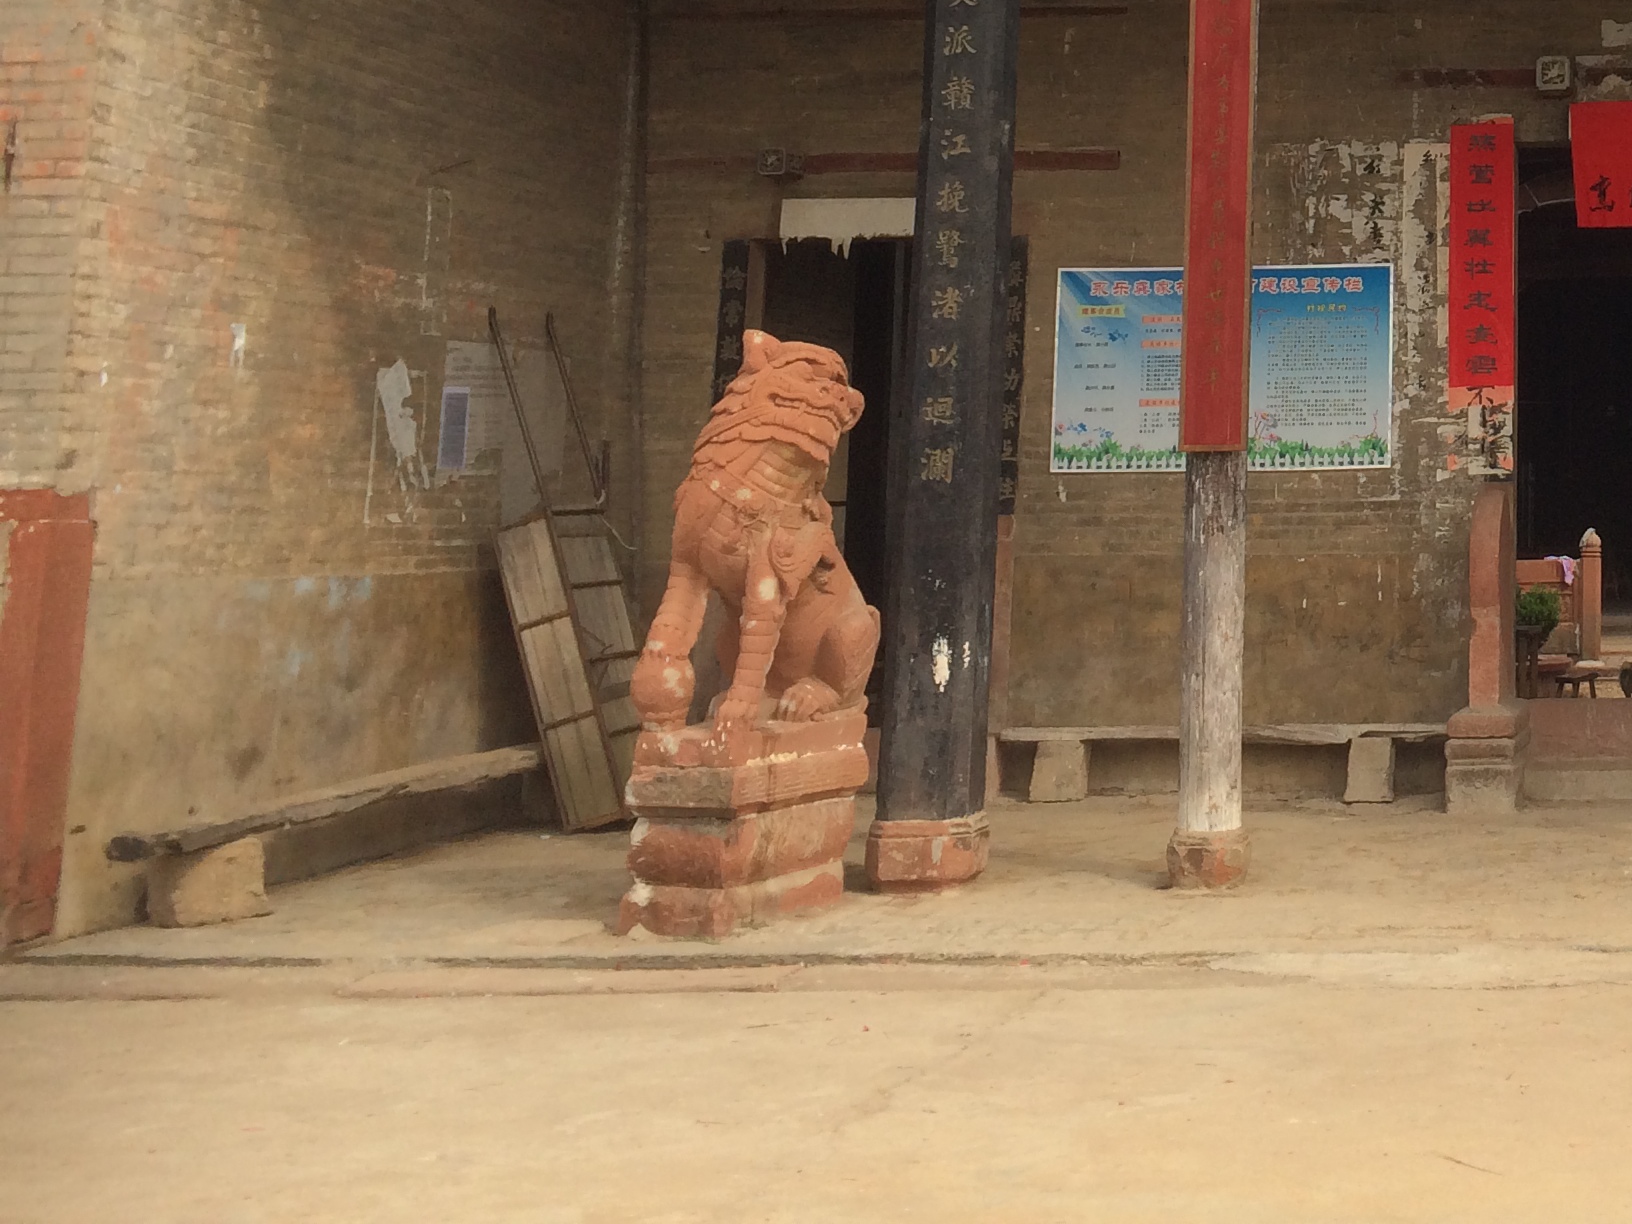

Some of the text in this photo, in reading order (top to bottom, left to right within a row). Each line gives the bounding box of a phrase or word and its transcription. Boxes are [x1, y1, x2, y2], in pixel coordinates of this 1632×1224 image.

[1252, 276, 1364, 294] 建设宣传栏
